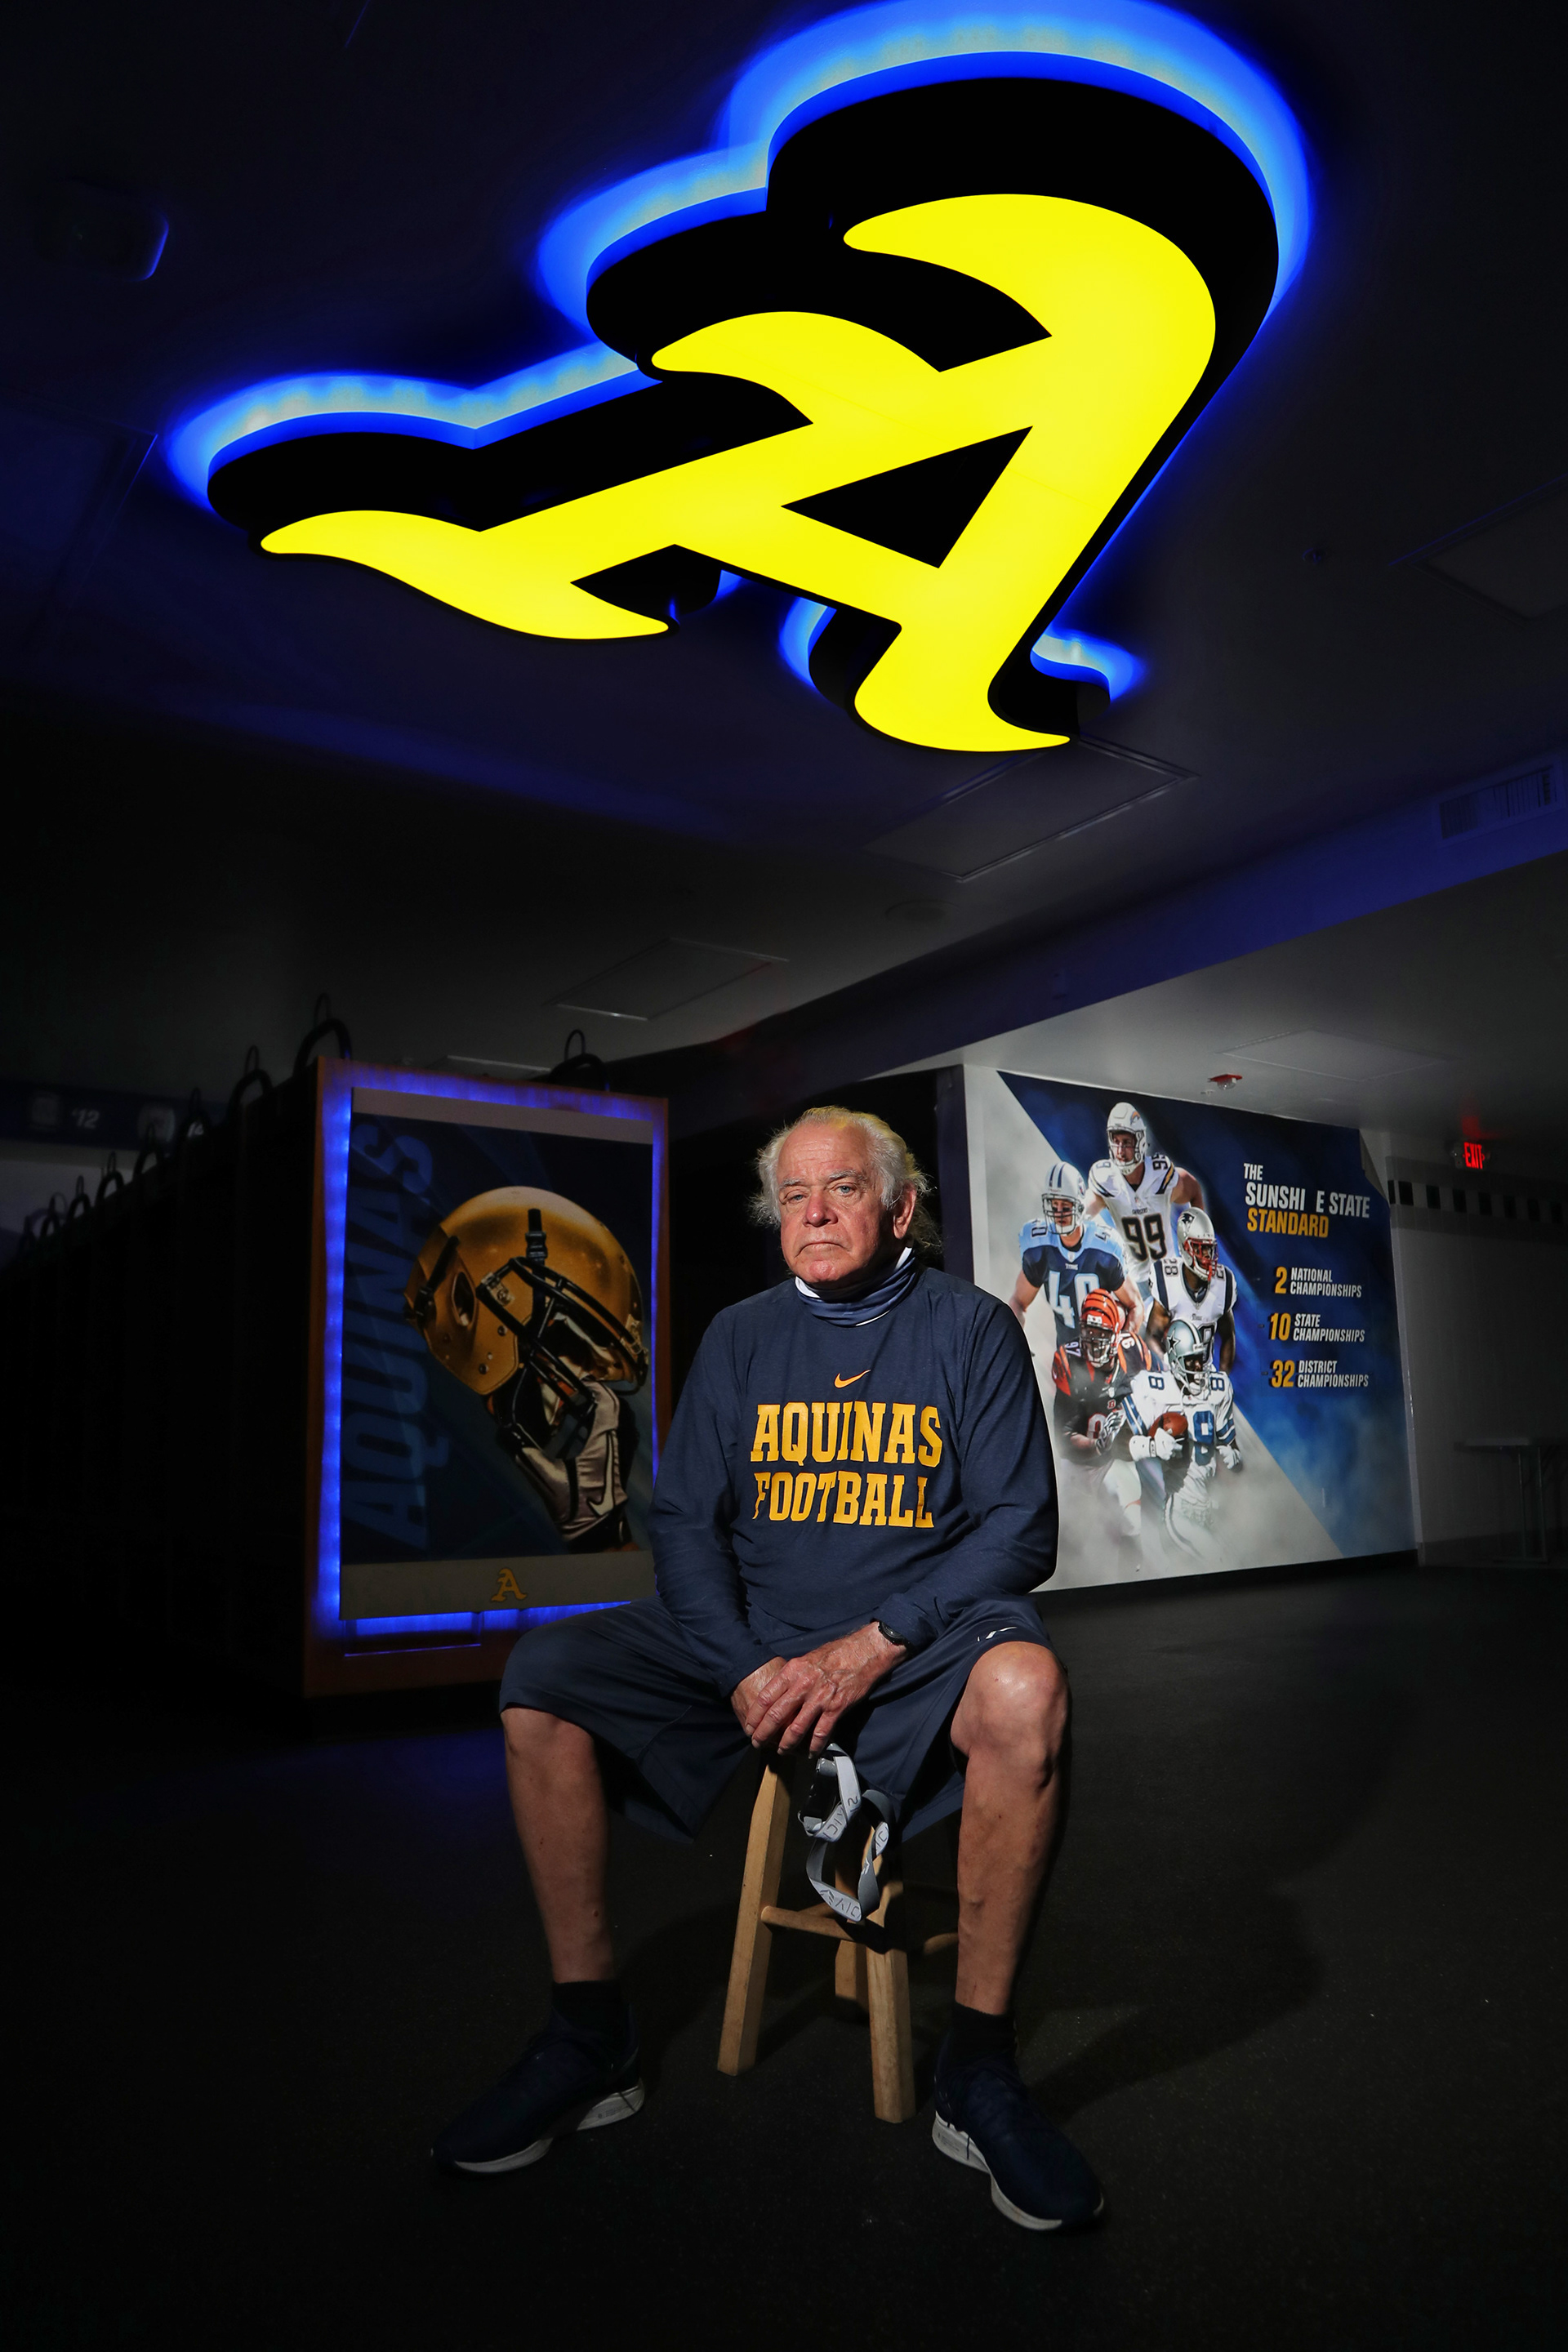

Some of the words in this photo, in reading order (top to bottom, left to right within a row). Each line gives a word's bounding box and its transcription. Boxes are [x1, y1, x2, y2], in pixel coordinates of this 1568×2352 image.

[261, 193, 1217, 752] A
[1463, 1142, 1483, 1169] EXIT
[1244, 1163, 1263, 1181] THE
[1329, 1192, 1370, 1218] STATE
[1122, 1214, 1166, 1260] 99
[1247, 1208, 1329, 1238] STANDARD
[1275, 1267, 1288, 1294] 2
[1290, 1267, 1333, 1282] NATIONAL
[1290, 1281, 1362, 1298] CHAMPIONSHIPS
[339, 1125, 450, 1550] AQUINAS
[1271, 1313, 1291, 1341] 10
[1294, 1313, 1321, 1327] STATE
[1293, 1328, 1365, 1342] CHAMPIONSHIPS
[1272, 1360, 1295, 1388] 32
[1298, 1361, 1337, 1374] DISTRICT
[1298, 1374, 1369, 1388] CHAMPIONSHIPS
[750, 1401, 943, 1468] AQUINAS
[752, 1470, 934, 1529] FOOTBALL
[491, 1567, 528, 1601] A
